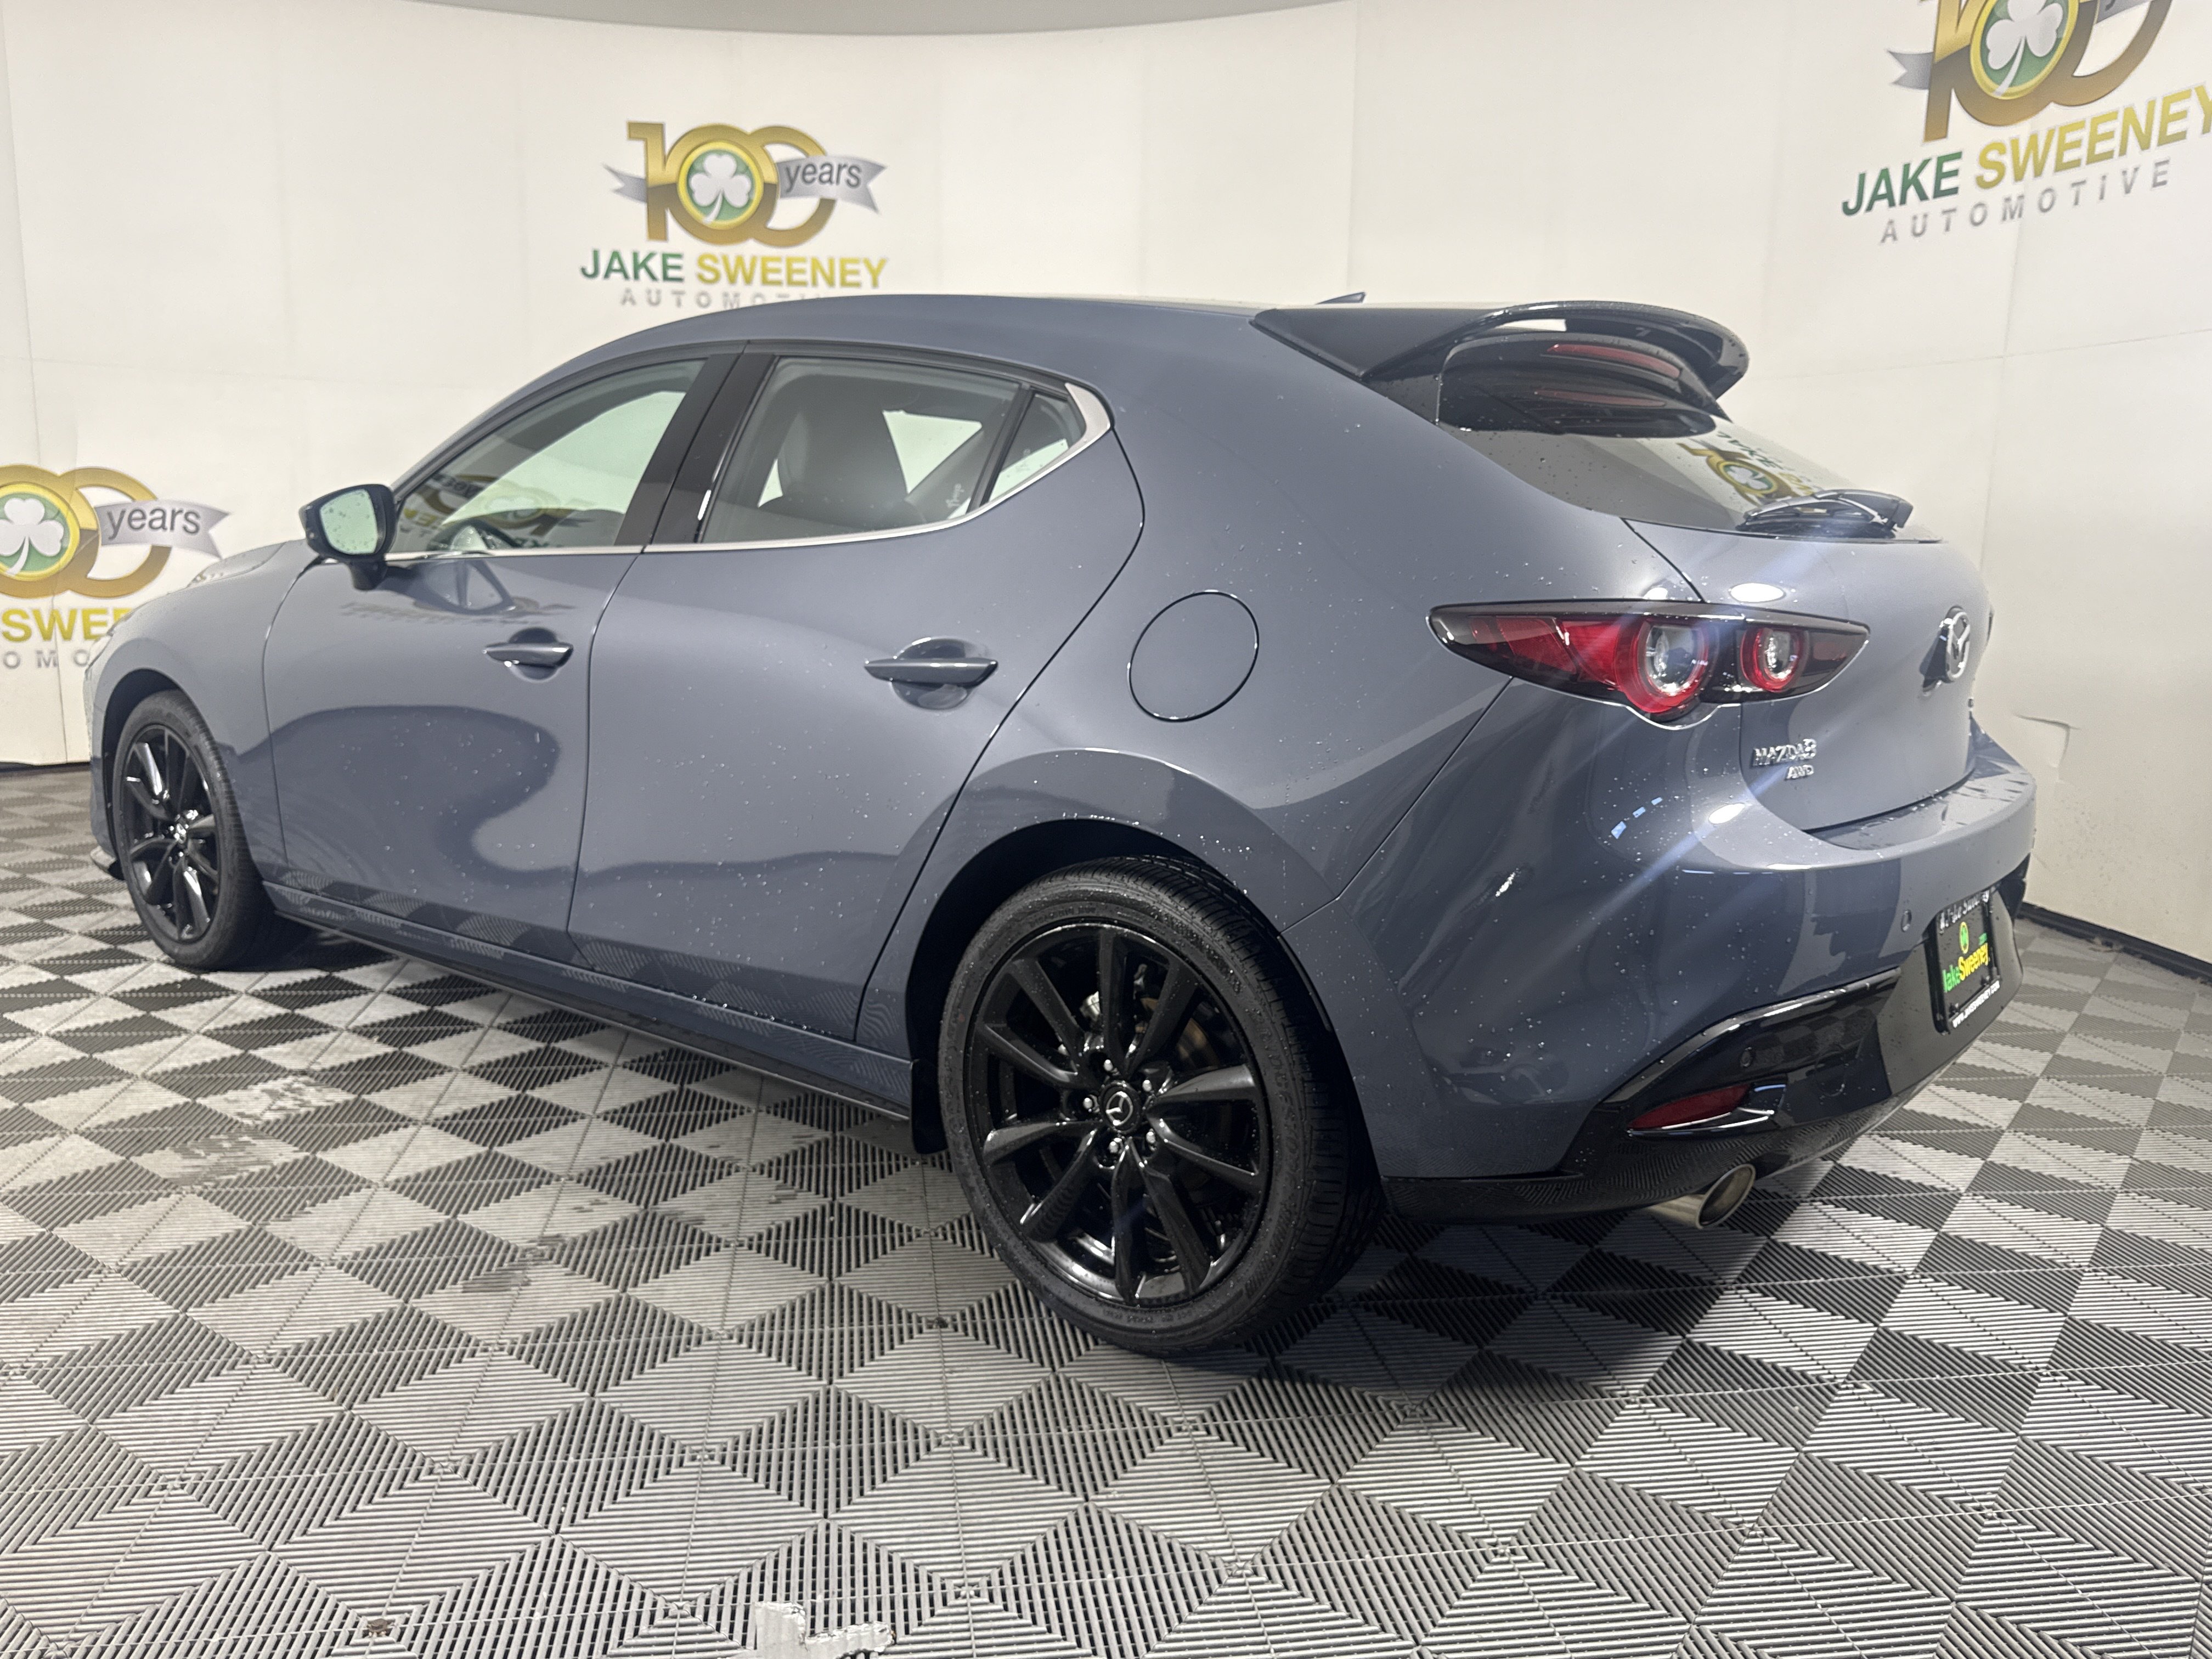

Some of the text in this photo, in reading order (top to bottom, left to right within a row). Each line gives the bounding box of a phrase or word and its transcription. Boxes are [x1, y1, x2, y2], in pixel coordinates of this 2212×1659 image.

[627, 120, 861, 247] 100 years
[1842, 84, 2212, 217] JAKE SWEENEY
[1881, 159, 2170, 244] AUTOMOTIVE
[580, 249, 888, 289] JAKE SWEENEY
[107, 507, 201, 540] years
